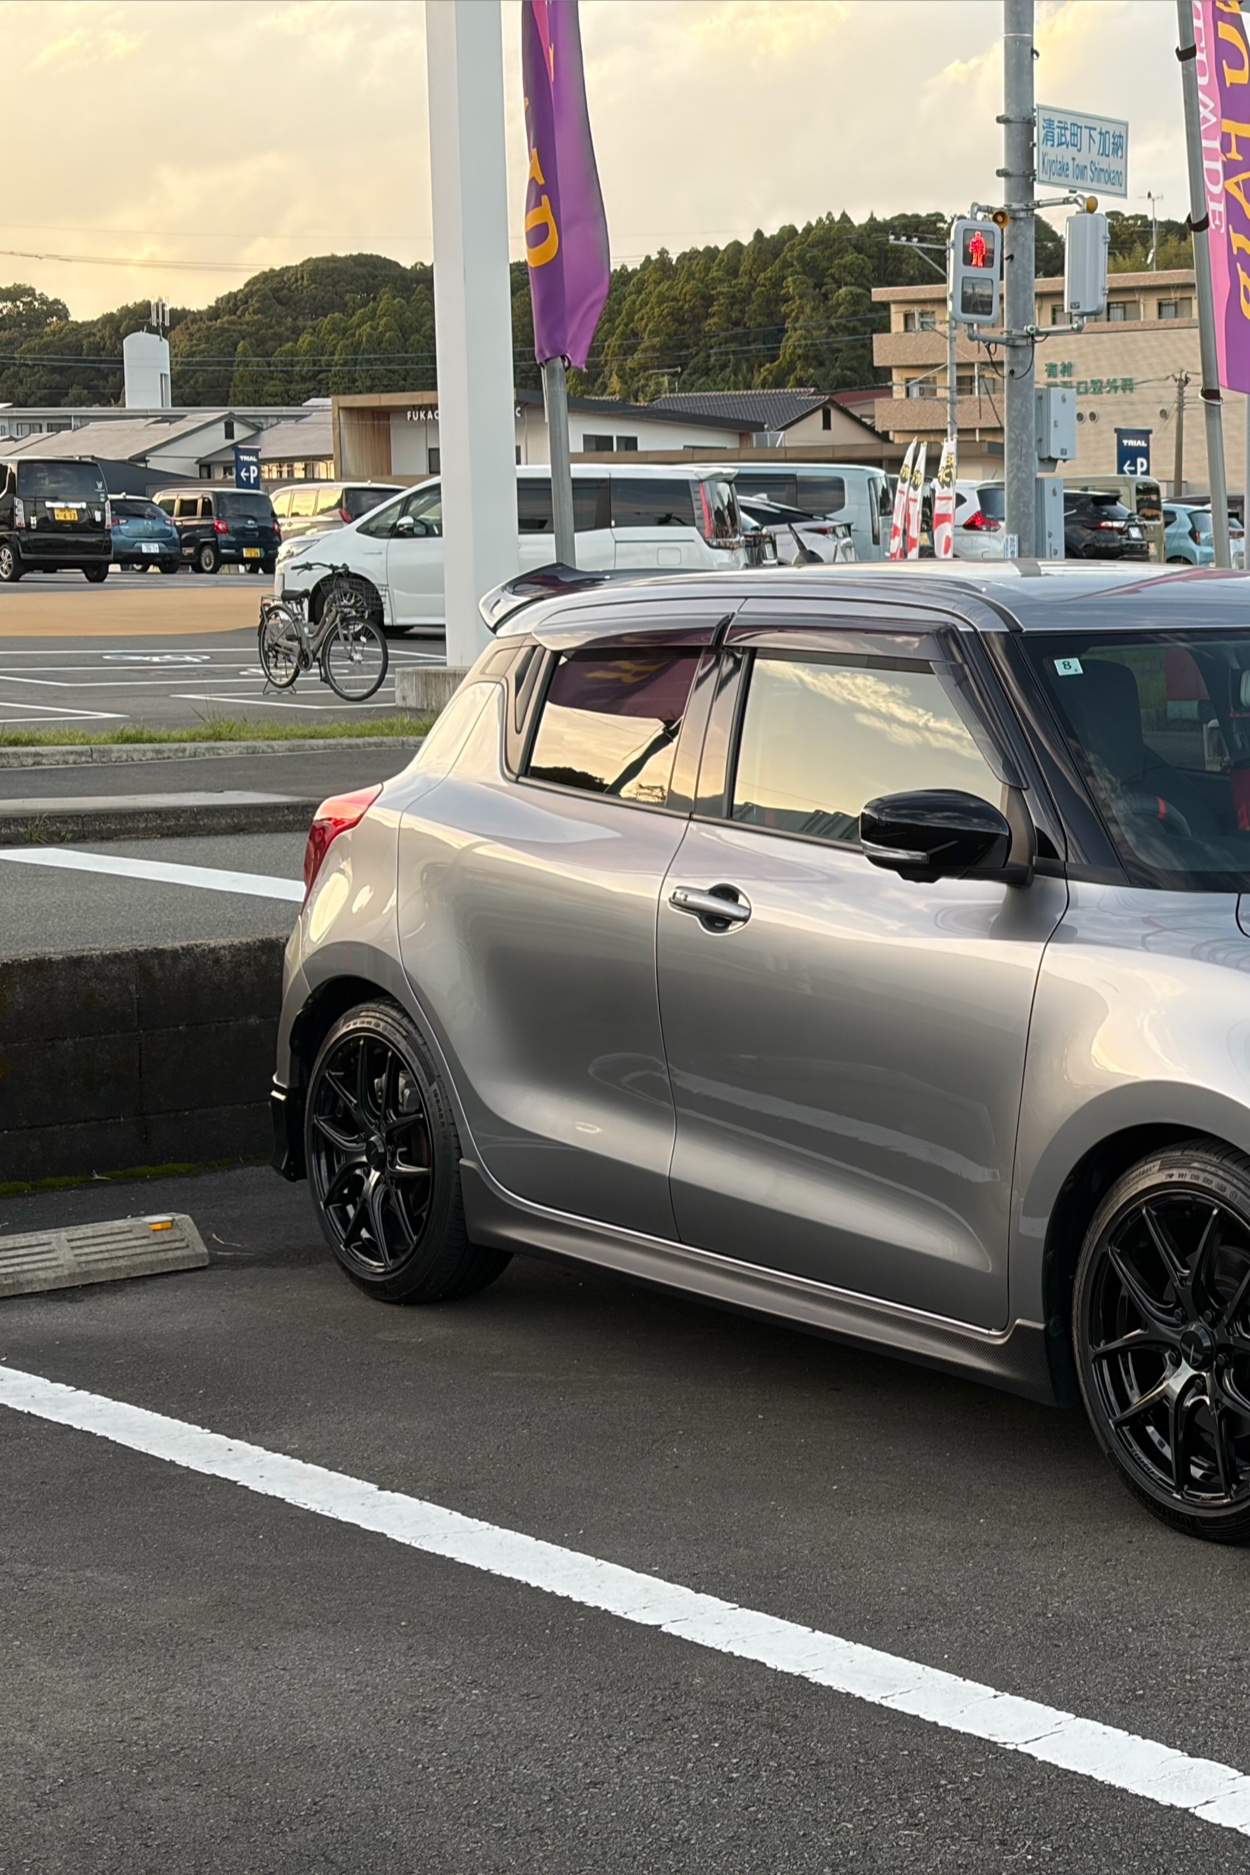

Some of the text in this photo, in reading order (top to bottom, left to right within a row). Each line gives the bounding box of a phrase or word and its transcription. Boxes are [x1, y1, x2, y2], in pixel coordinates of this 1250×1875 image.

[1042, 117, 1124, 159] 清武町下加納
[1042, 151, 1069, 180] Kiyotake
[1072, 157, 1088, 181] Town
[250, 465, 258, 484] P
[1136, 457, 1148, 476] P
[1062, 660, 1072, 670] 8
